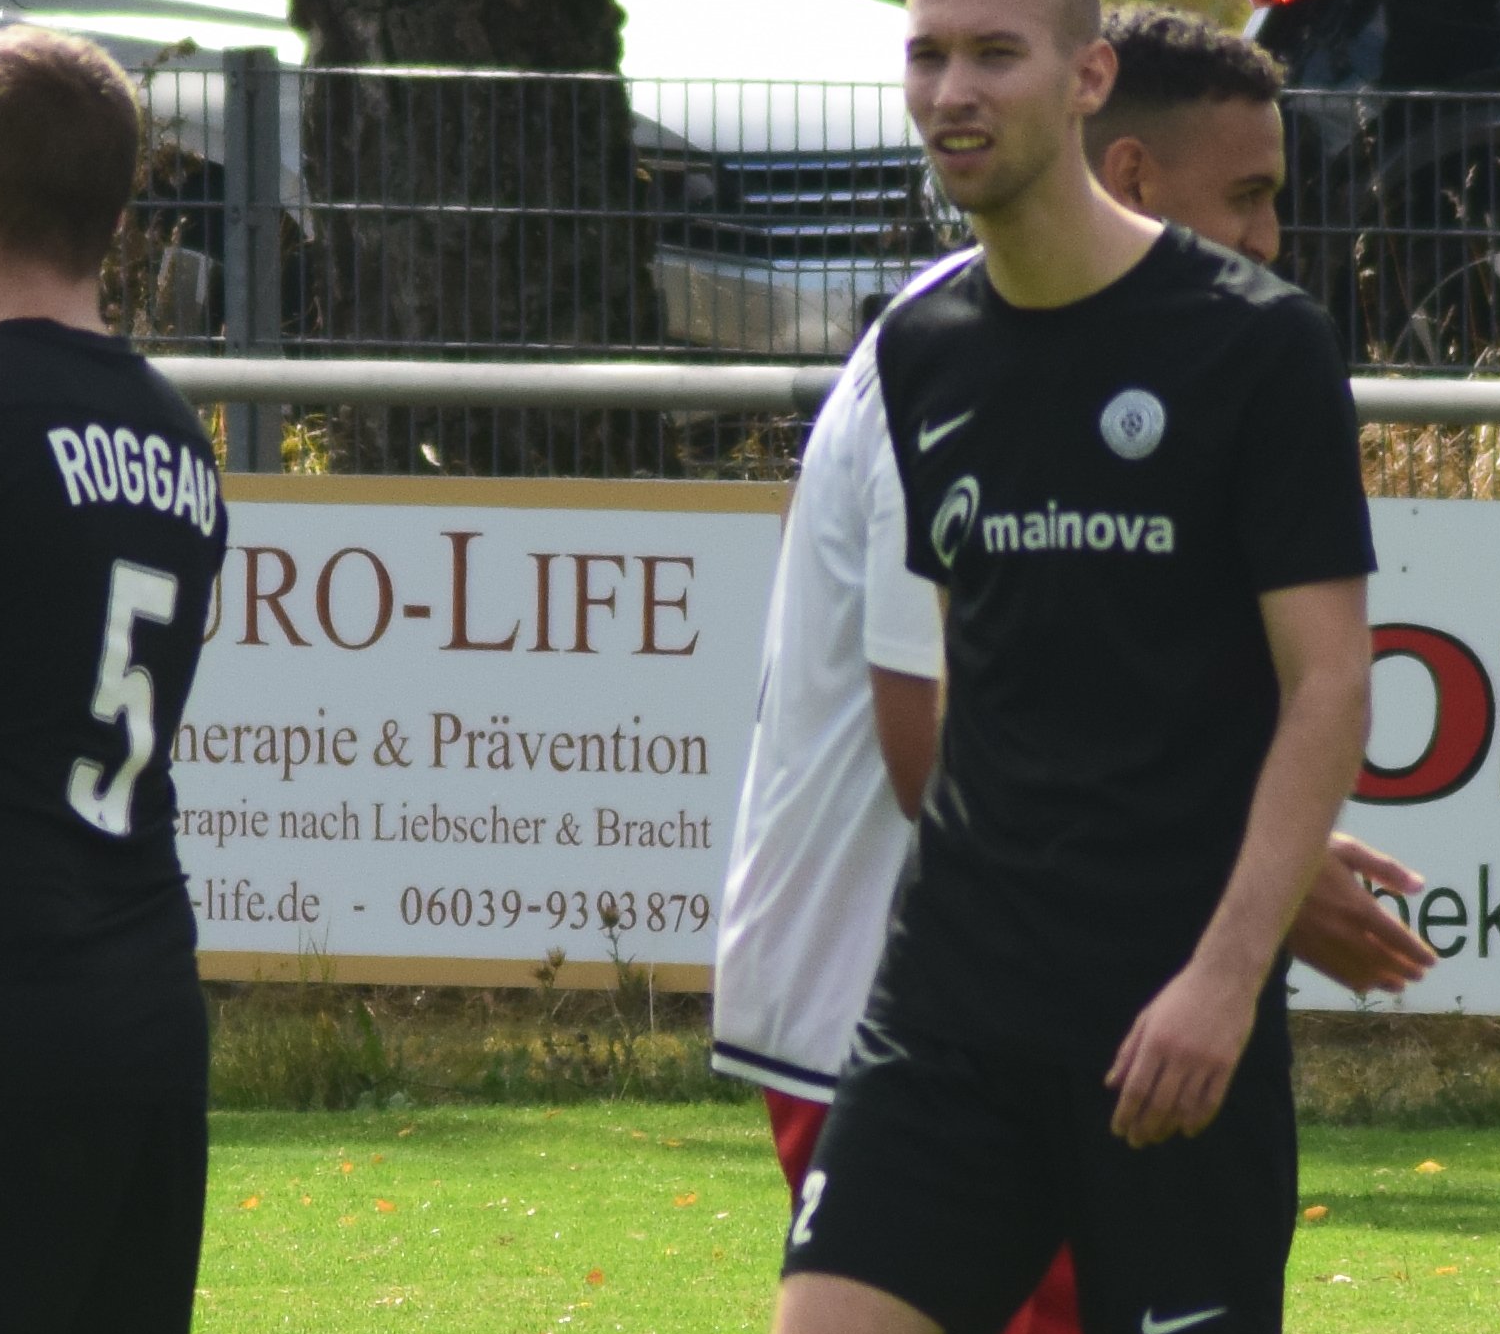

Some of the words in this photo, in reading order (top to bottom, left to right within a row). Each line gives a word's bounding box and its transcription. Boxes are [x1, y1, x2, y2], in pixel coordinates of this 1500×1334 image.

[47, 423, 217, 537] ROGGAU
[982, 499, 1175, 554] mainova
[66, 558, 179, 838] 5
[372, 719, 414, 768] &
[431, 712, 709, 777] Prävention
[279, 802, 361, 842] nach
[372, 802, 548, 848] Liebscher
[555, 813, 583, 847] &
[595, 808, 713, 850] Bracht
